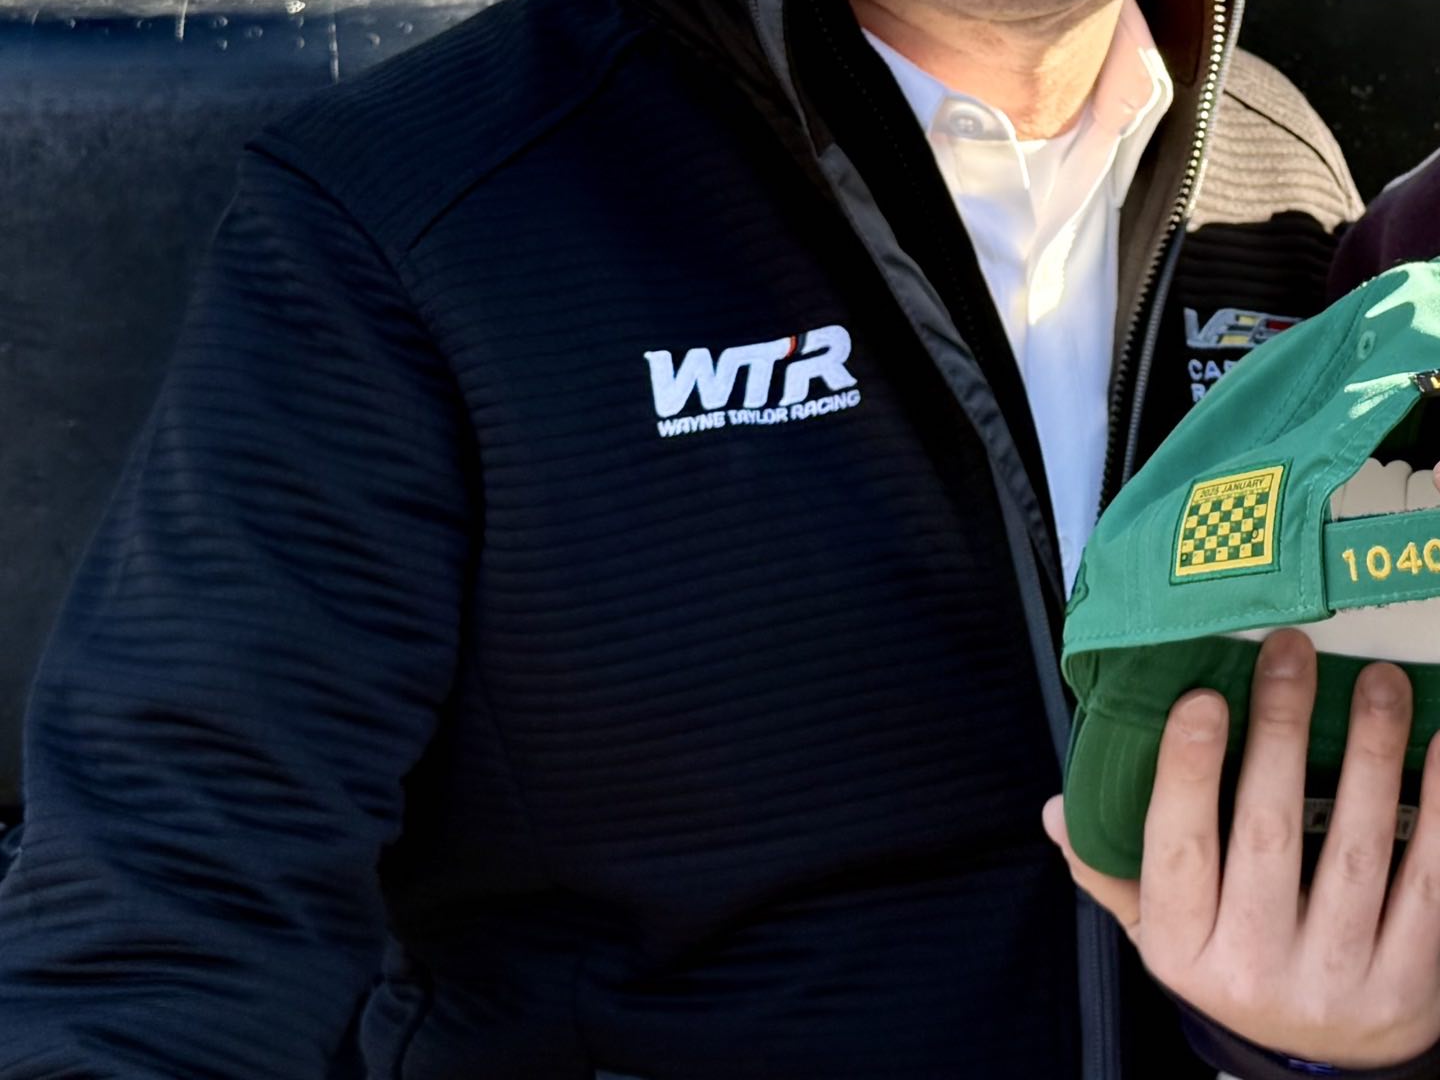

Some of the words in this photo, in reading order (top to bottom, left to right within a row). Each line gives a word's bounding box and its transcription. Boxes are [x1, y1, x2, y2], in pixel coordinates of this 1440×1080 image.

[644, 324, 858, 418] WTR
[657, 410, 725, 437] WAYNE
[728, 407, 788, 425] TAYLOR
[790, 389, 861, 420] RACING
